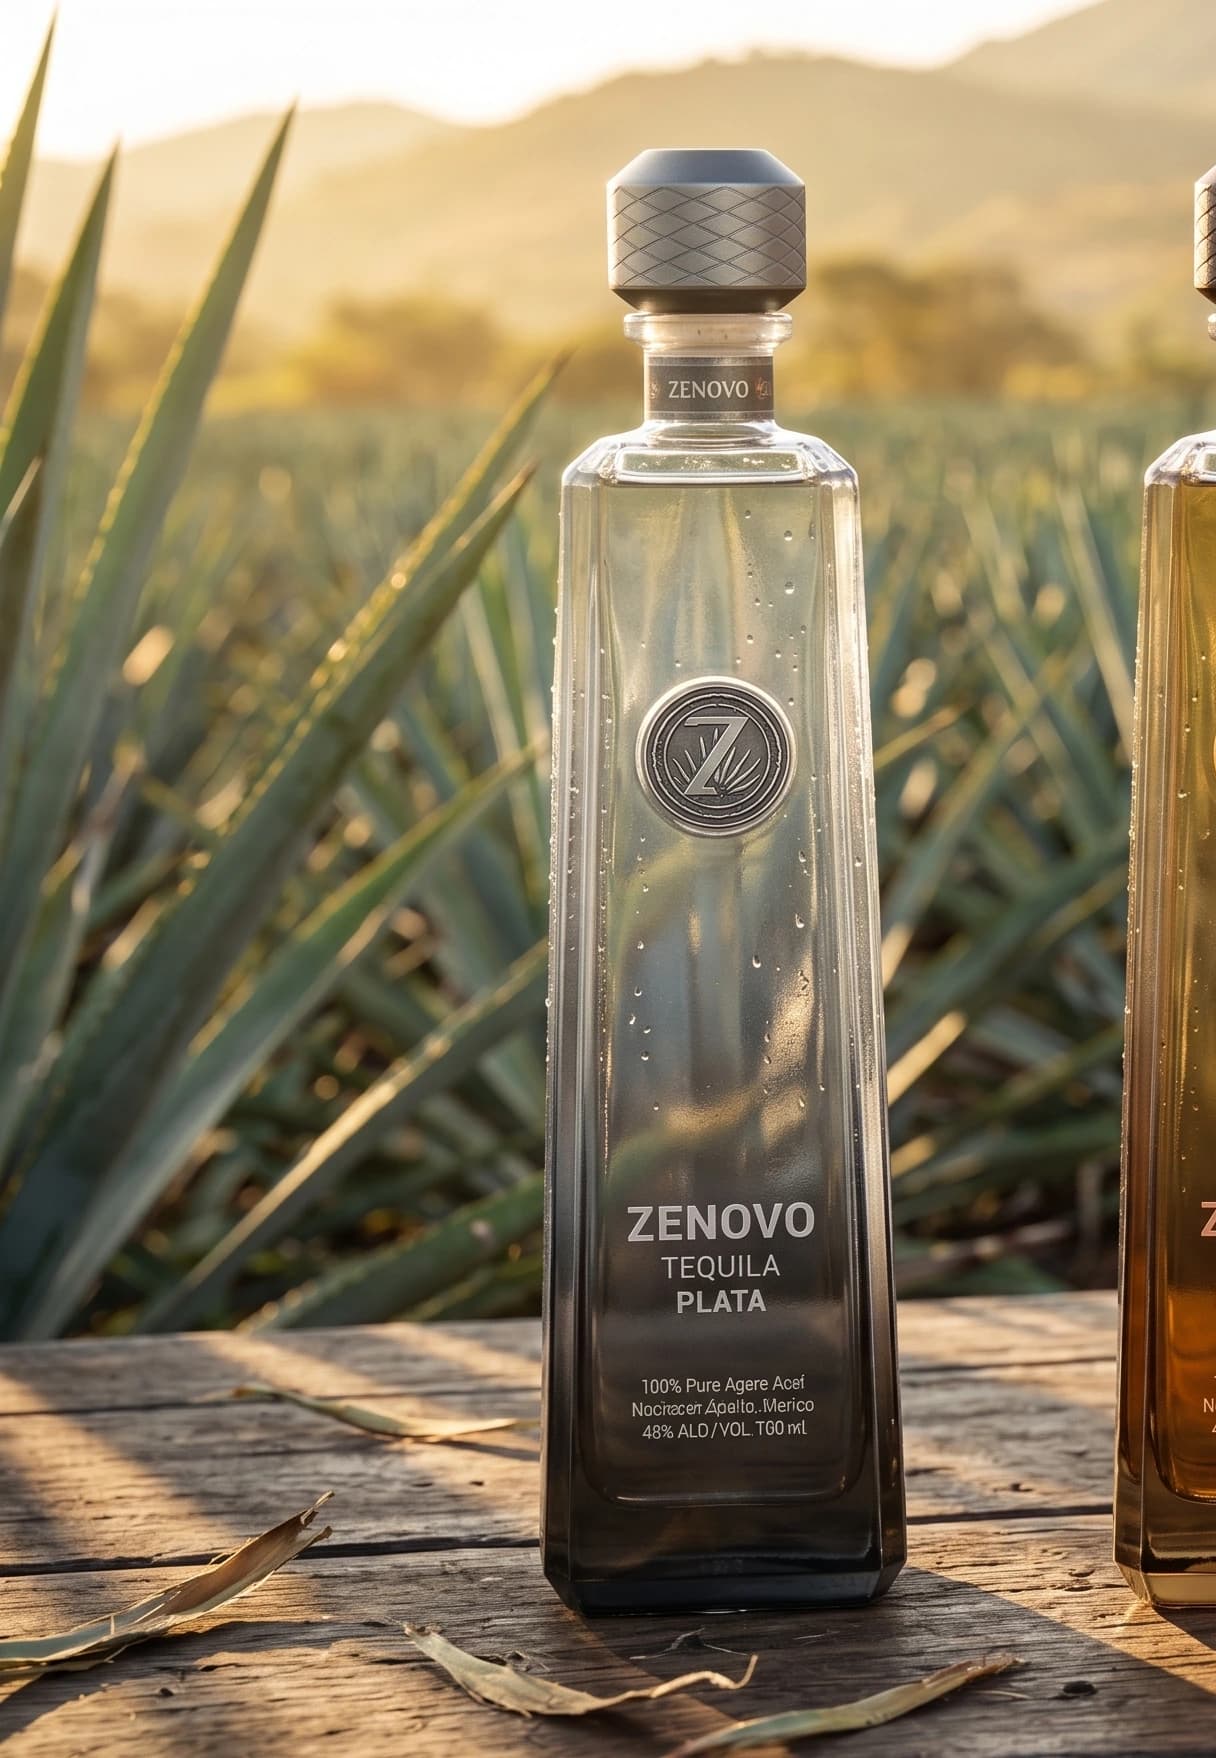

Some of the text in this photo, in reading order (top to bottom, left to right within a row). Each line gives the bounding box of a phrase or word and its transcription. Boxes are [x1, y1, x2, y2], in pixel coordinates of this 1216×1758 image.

[668, 380, 749, 399] ZENOVO
[627, 1201, 815, 1242] ZENOVO
[661, 1254, 781, 1281] TEQUILA
[676, 1289, 767, 1314] PLATA
[641, 1378, 682, 1395] 100%
[686, 1378, 721, 1393] Pure
[724, 1376, 769, 1395] Agere
[642, 1424, 674, 1440] 48%
